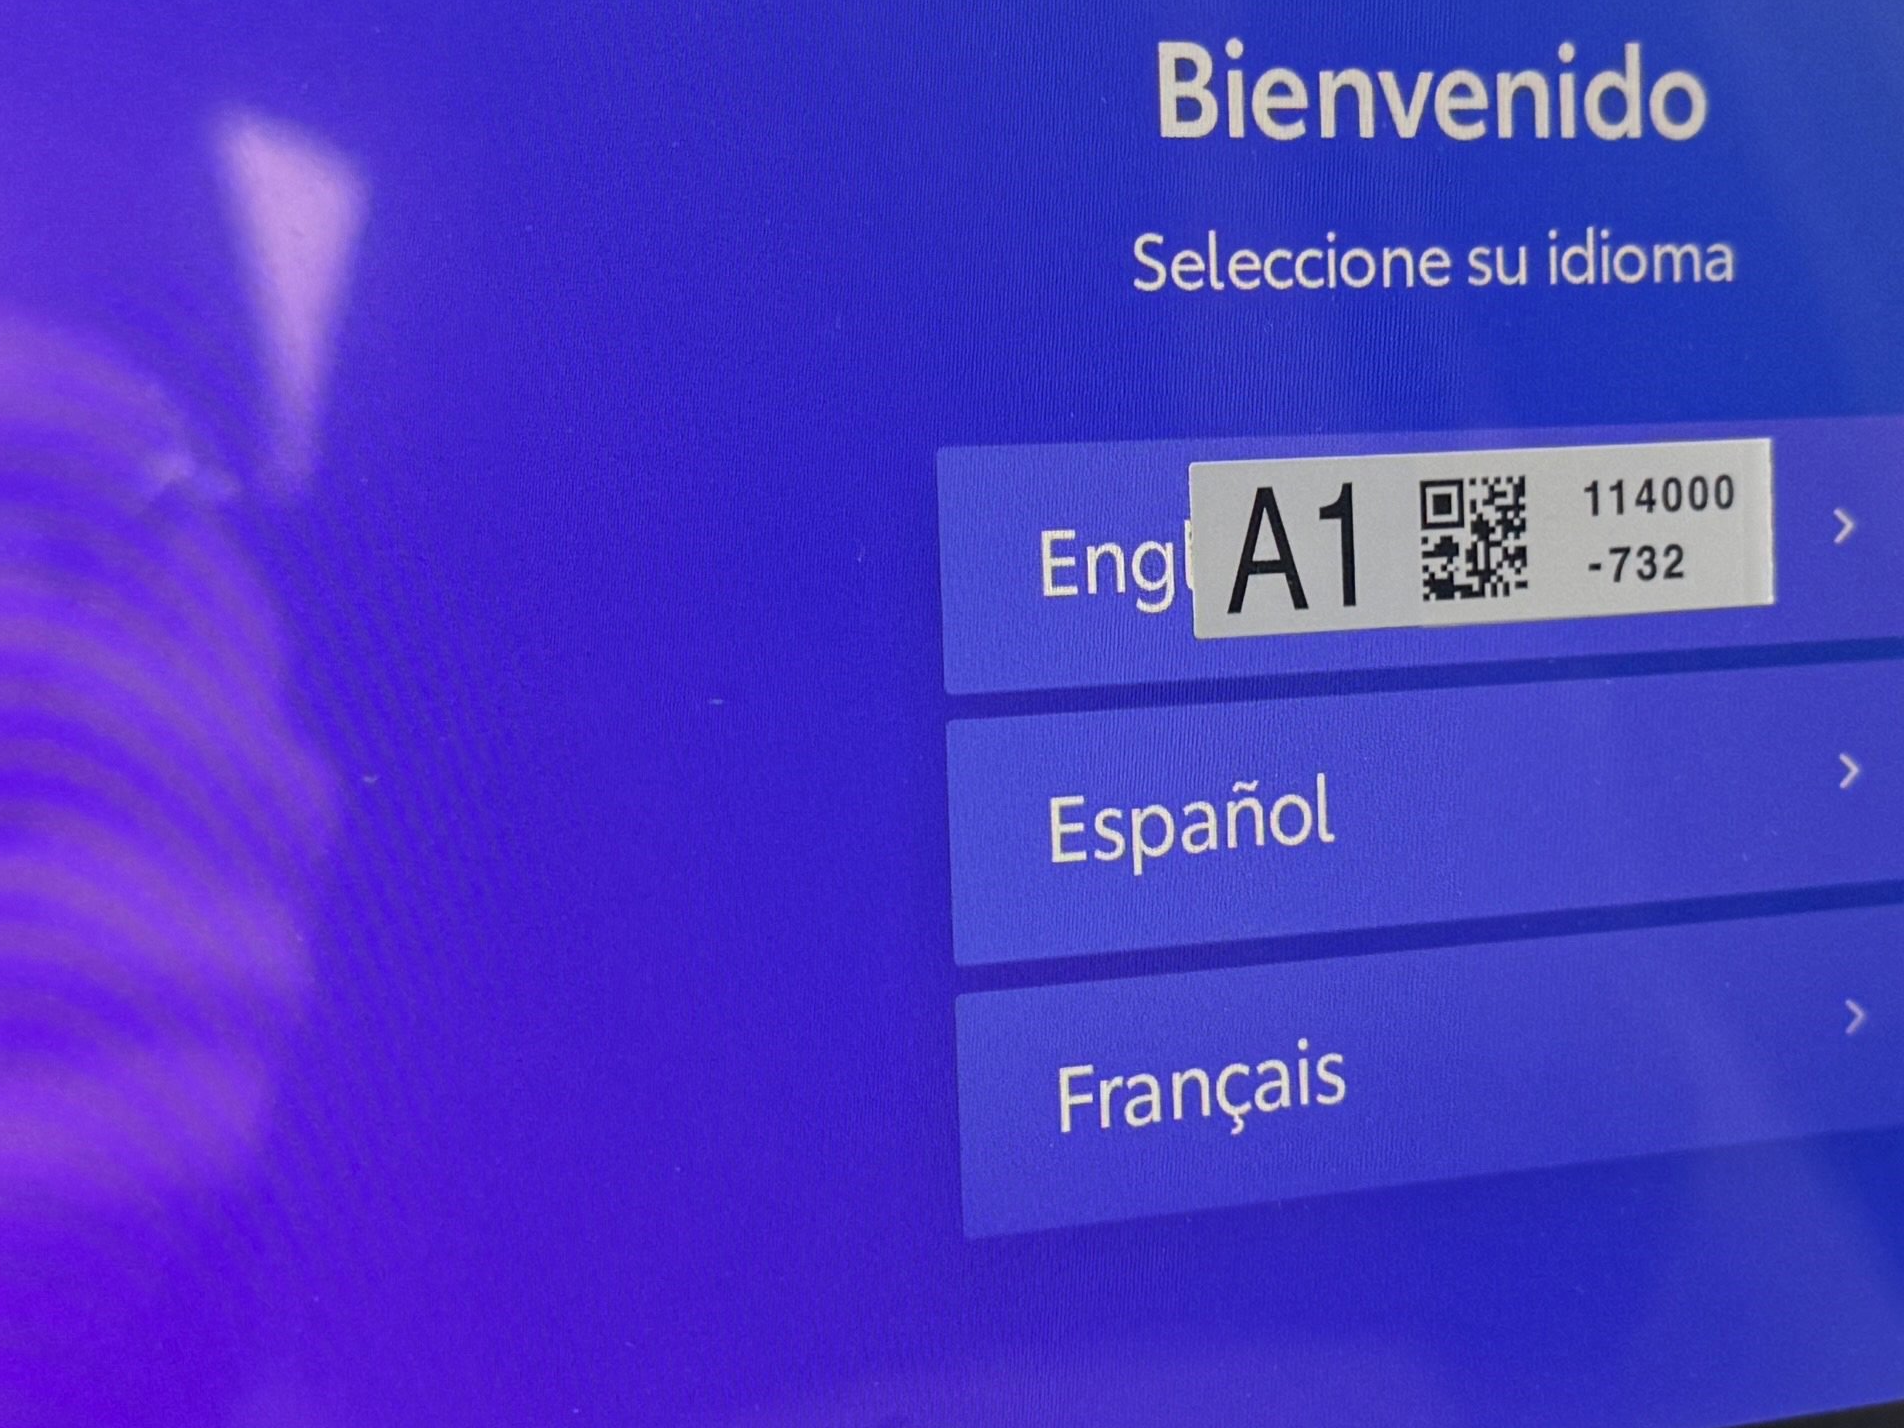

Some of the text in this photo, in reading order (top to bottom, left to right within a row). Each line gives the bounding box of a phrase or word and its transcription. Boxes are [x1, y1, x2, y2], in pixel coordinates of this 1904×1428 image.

[1156, 39, 1709, 141] Bienvenido
[1132, 227, 1736, 292] Seleccione su idioma
[1584, 475, 1735, 517] 114000
[1039, 518, 1194, 614] Engl
[1227, 482, 1360, 614] A1
[1588, 546, 1686, 582] -732
[1048, 773, 1335, 874] Español
[1058, 1038, 1347, 1134] Français
